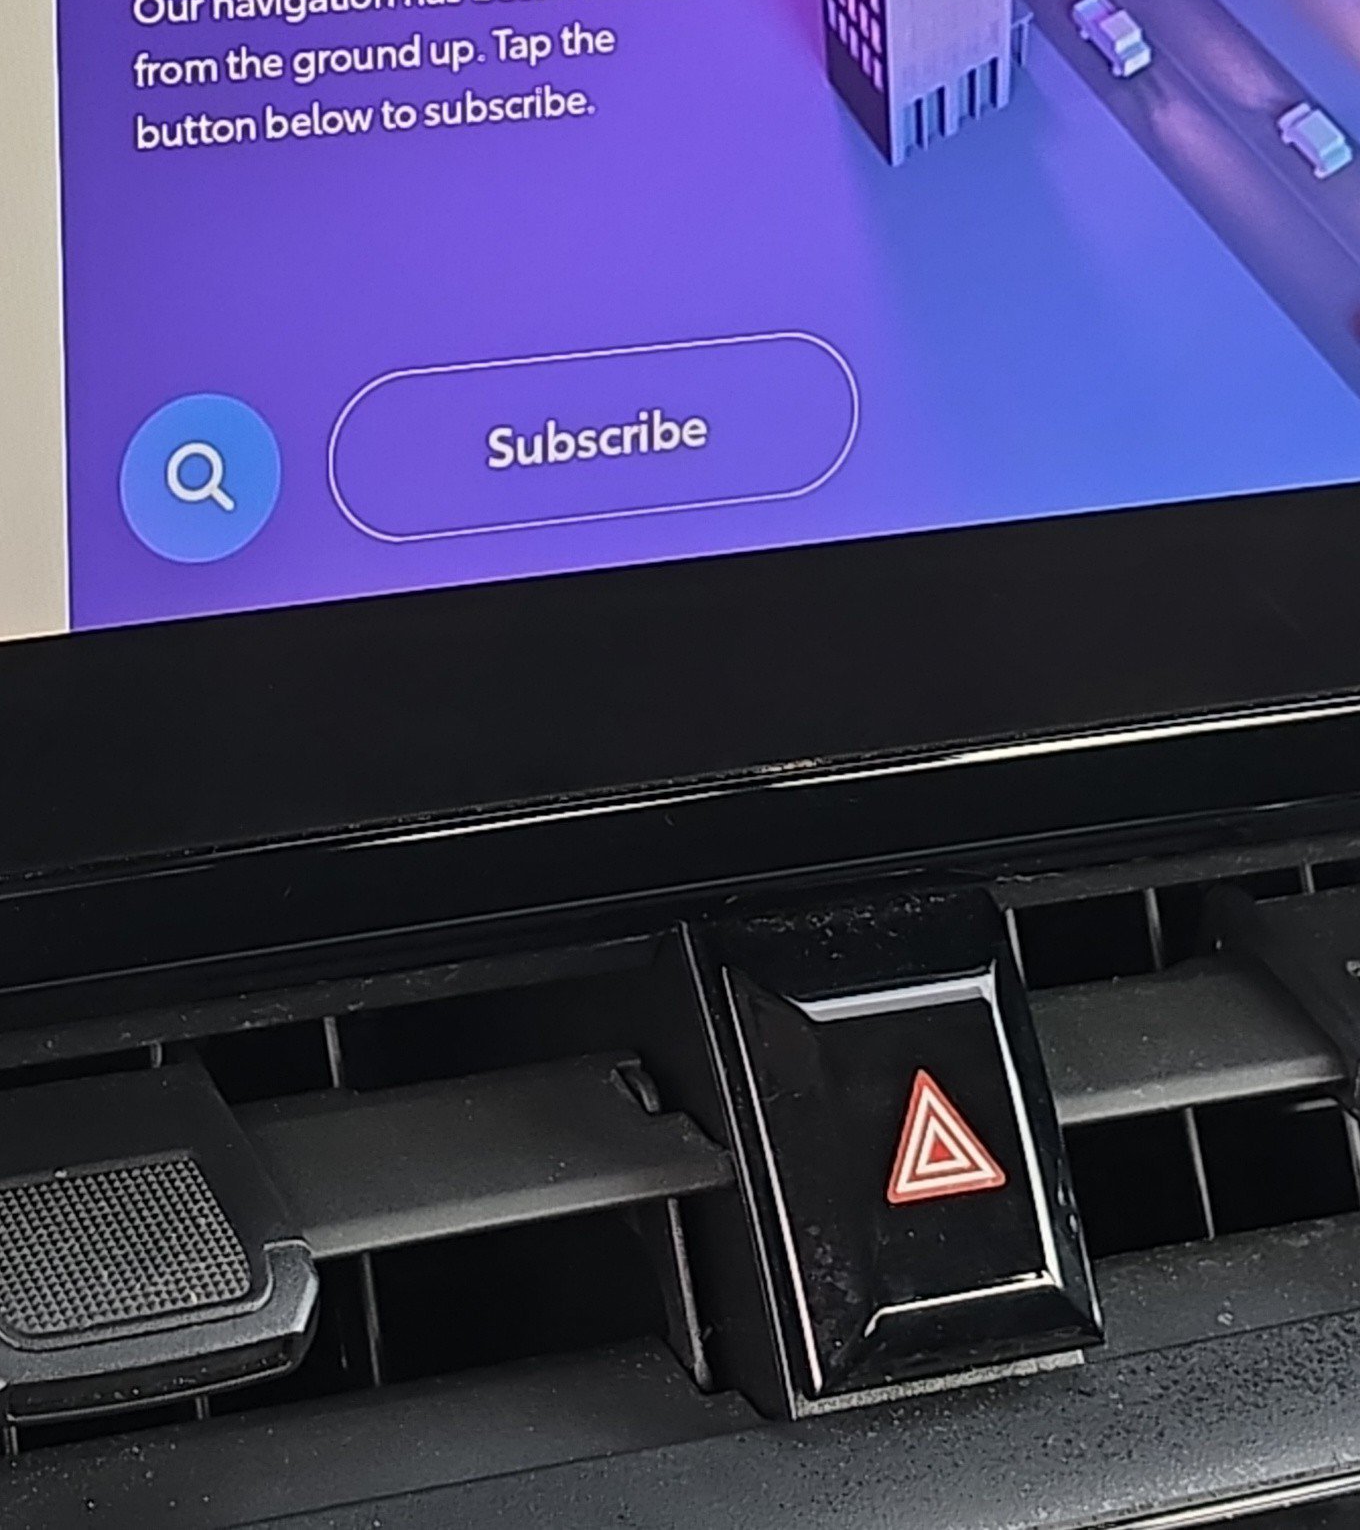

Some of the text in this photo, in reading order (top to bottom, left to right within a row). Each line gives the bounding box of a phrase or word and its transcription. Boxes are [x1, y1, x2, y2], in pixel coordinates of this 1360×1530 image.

[135, 21, 616, 88] from the ground up. Tap the
[136, 85, 597, 150] button below to subscribe.
[486, 409, 708, 470] Subscribe
